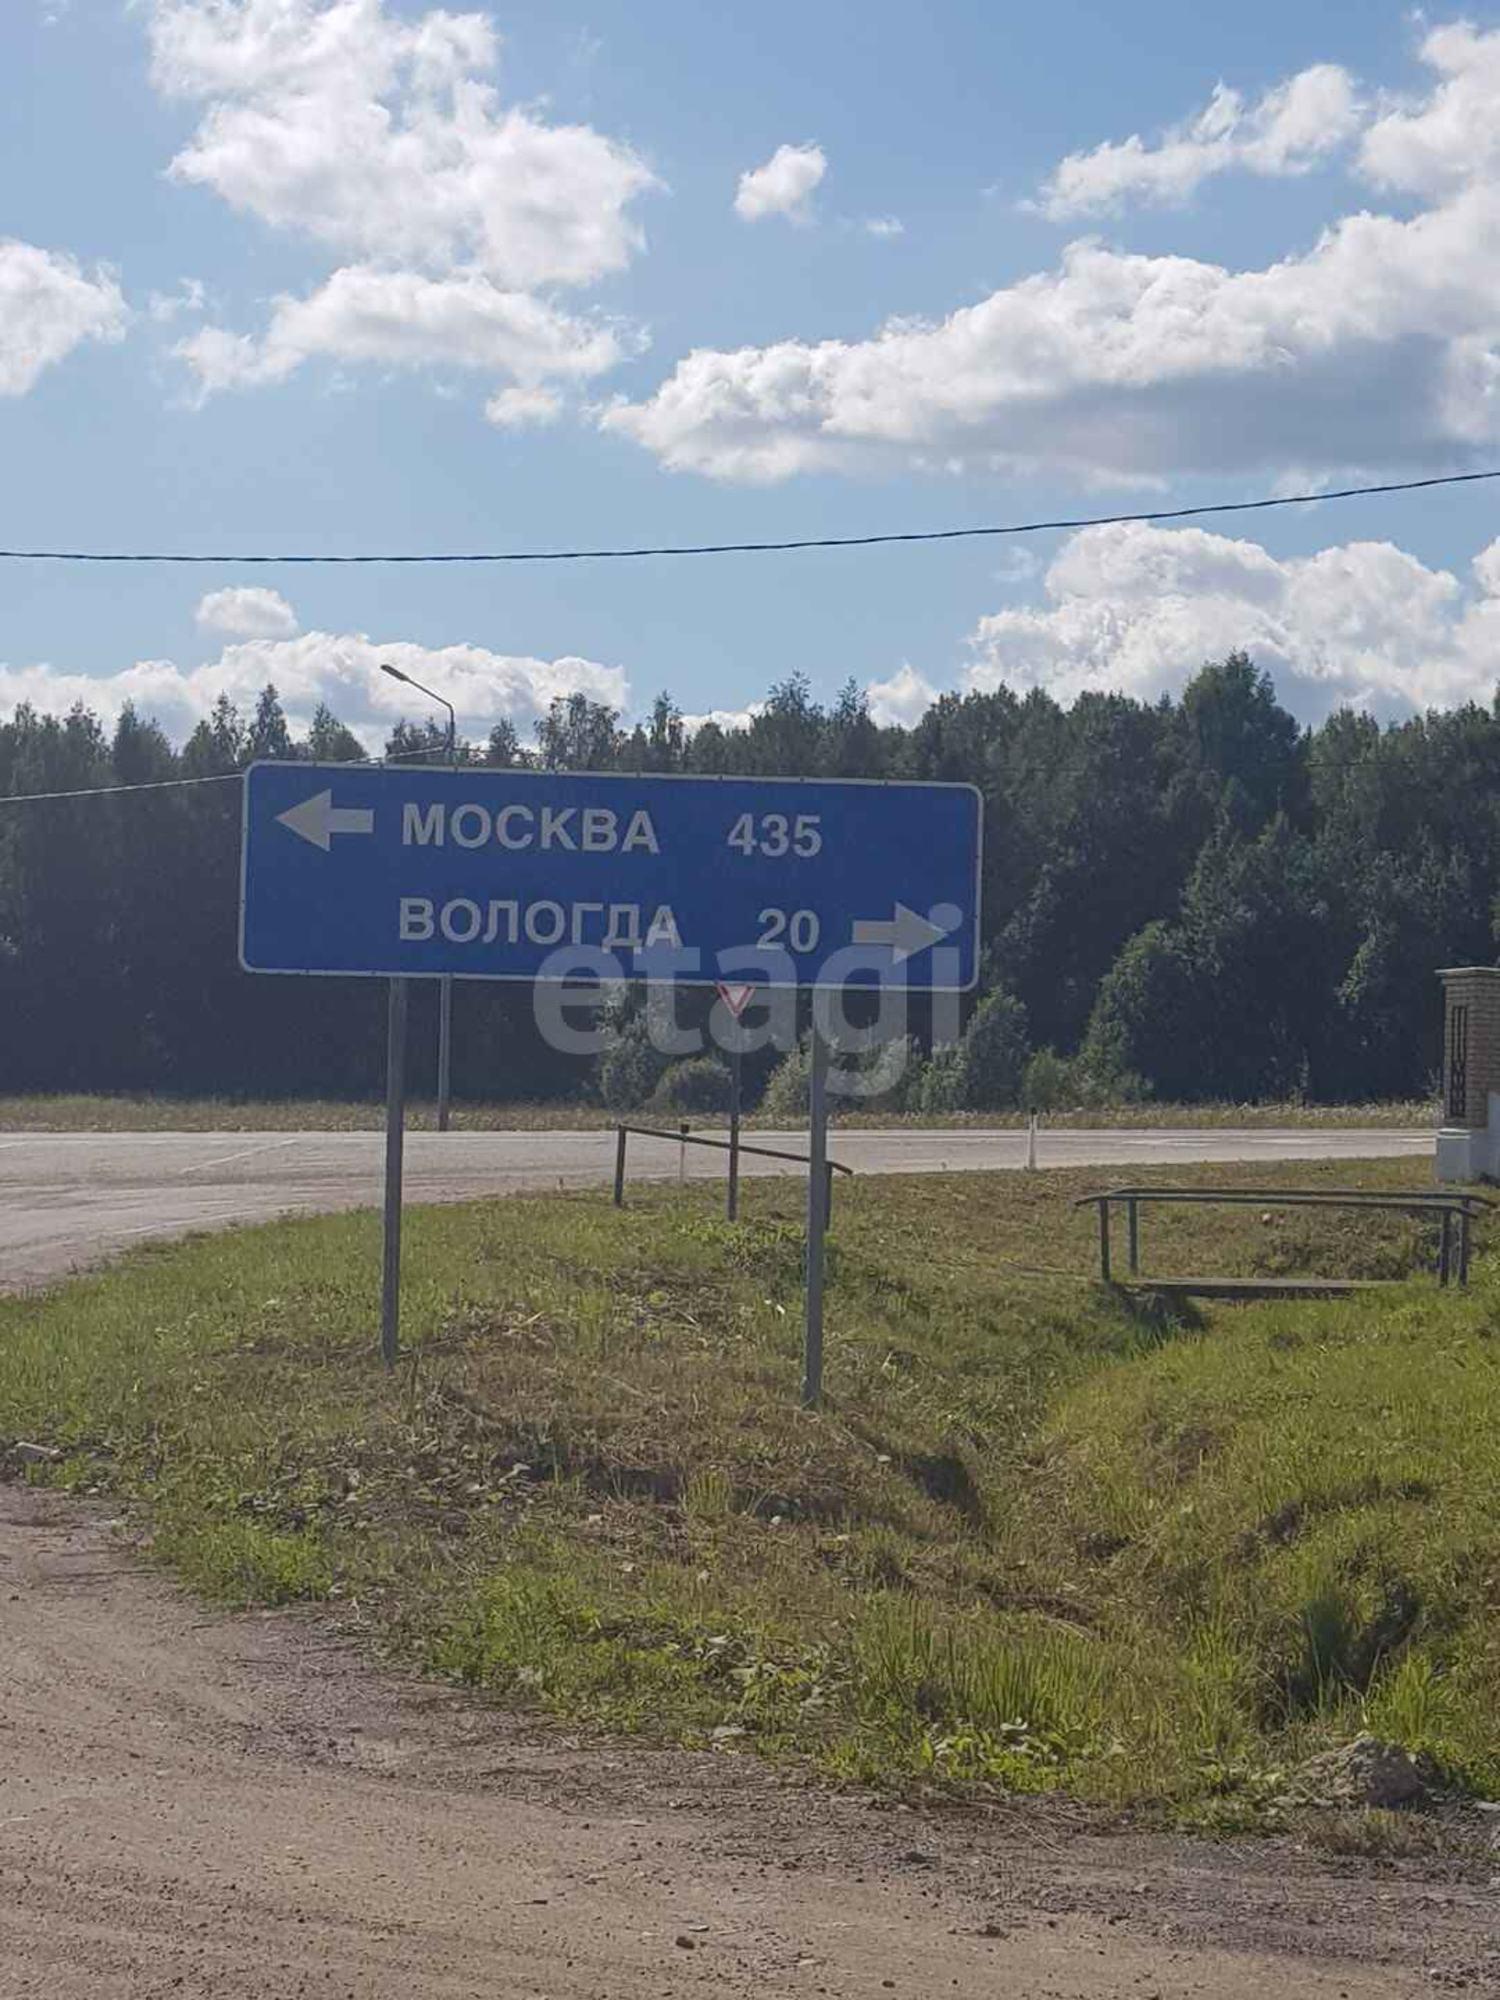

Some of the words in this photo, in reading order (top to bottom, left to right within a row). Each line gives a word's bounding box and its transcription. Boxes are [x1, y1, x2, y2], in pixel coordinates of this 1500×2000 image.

[401, 802, 660, 855] МОСКВА
[726, 812, 823, 858] 435
[398, 896, 684, 955] ВОЛОГДА
[756, 908, 821, 955] 20
